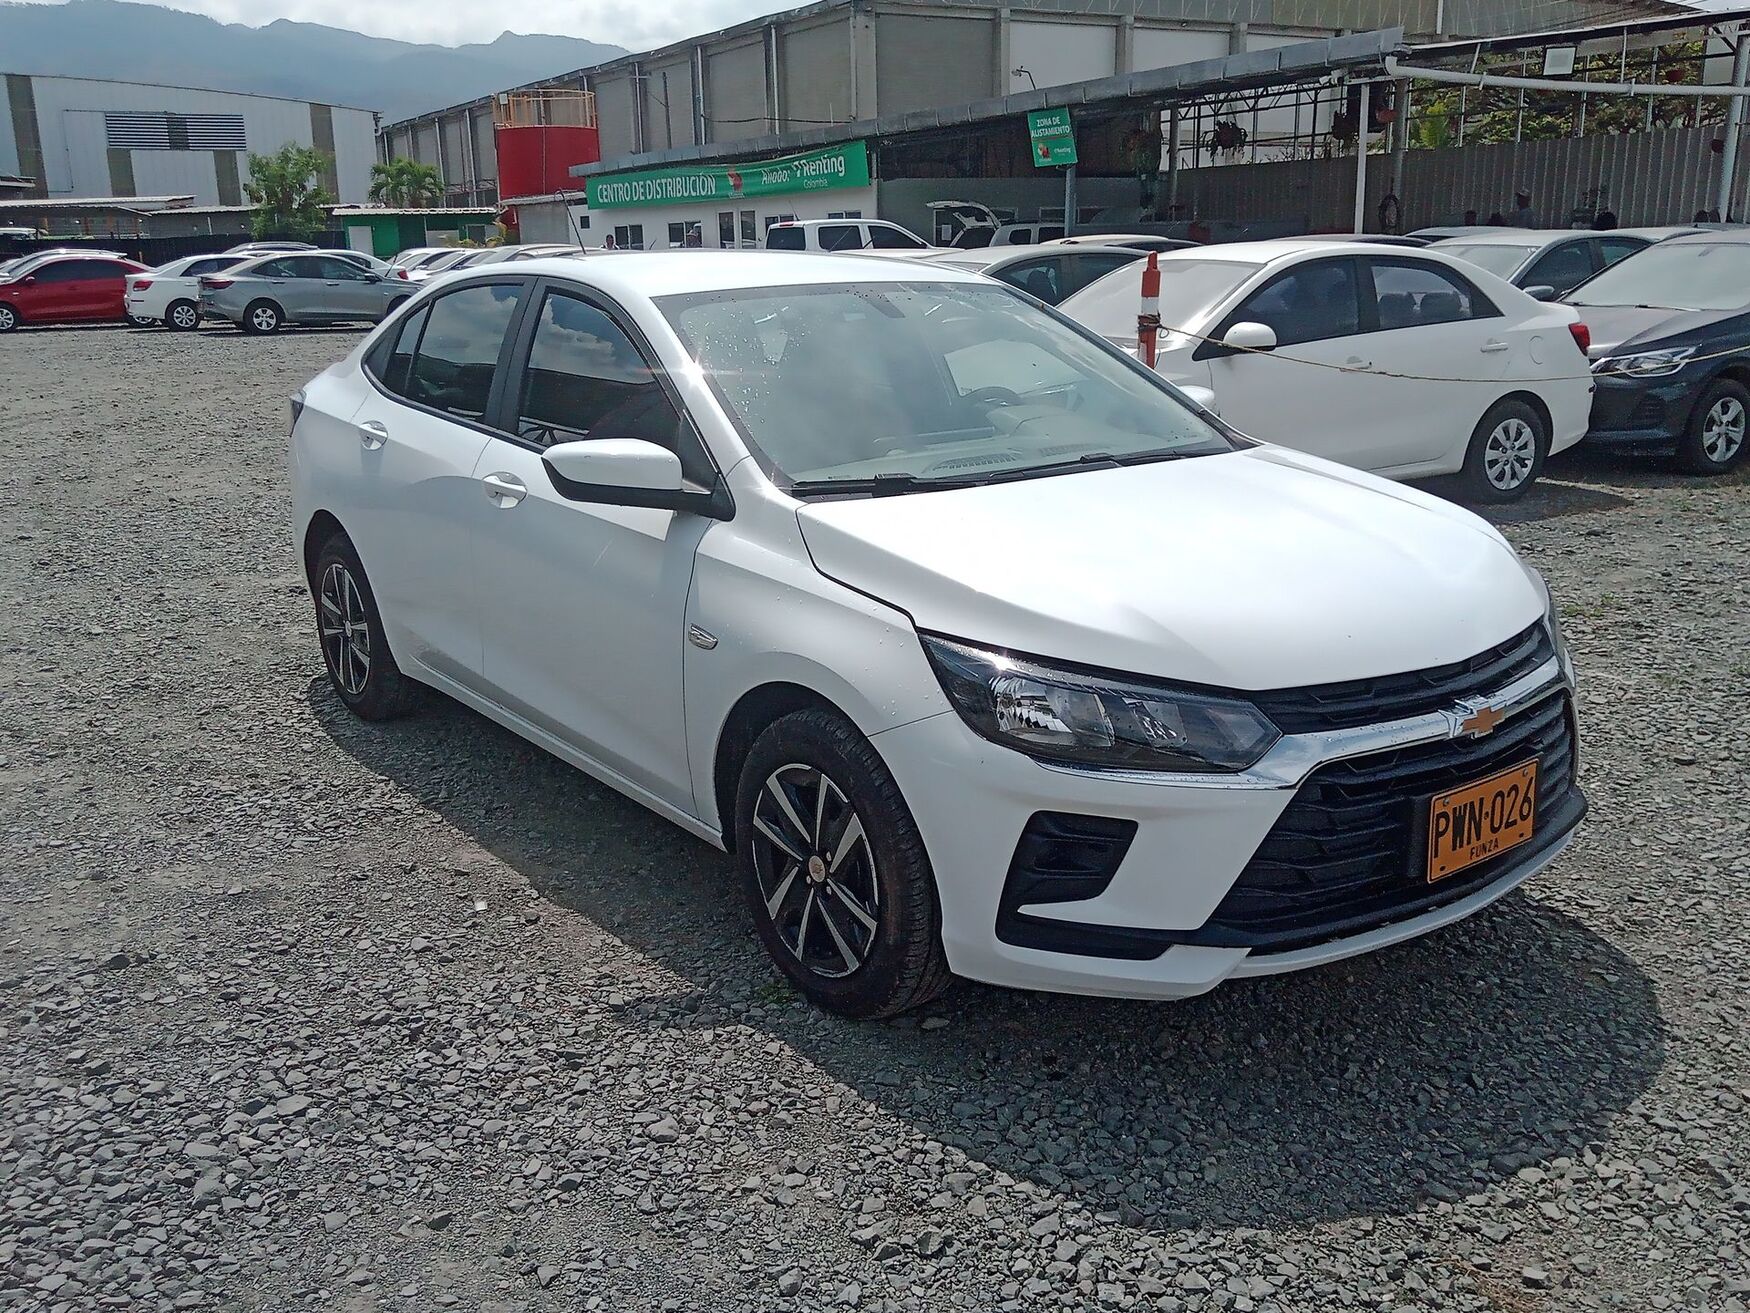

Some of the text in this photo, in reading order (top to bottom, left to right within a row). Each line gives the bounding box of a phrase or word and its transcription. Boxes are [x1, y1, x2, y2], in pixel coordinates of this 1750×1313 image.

[1031, 125, 1070, 138] ALISTAMIENTO
[1037, 116, 1060, 127] ZONA DE
[803, 154, 845, 177] Renting
[597, 172, 716, 203] CENTRO DE DISTRIBUCIÓN
[1470, 838, 1499, 860] FUNZA
